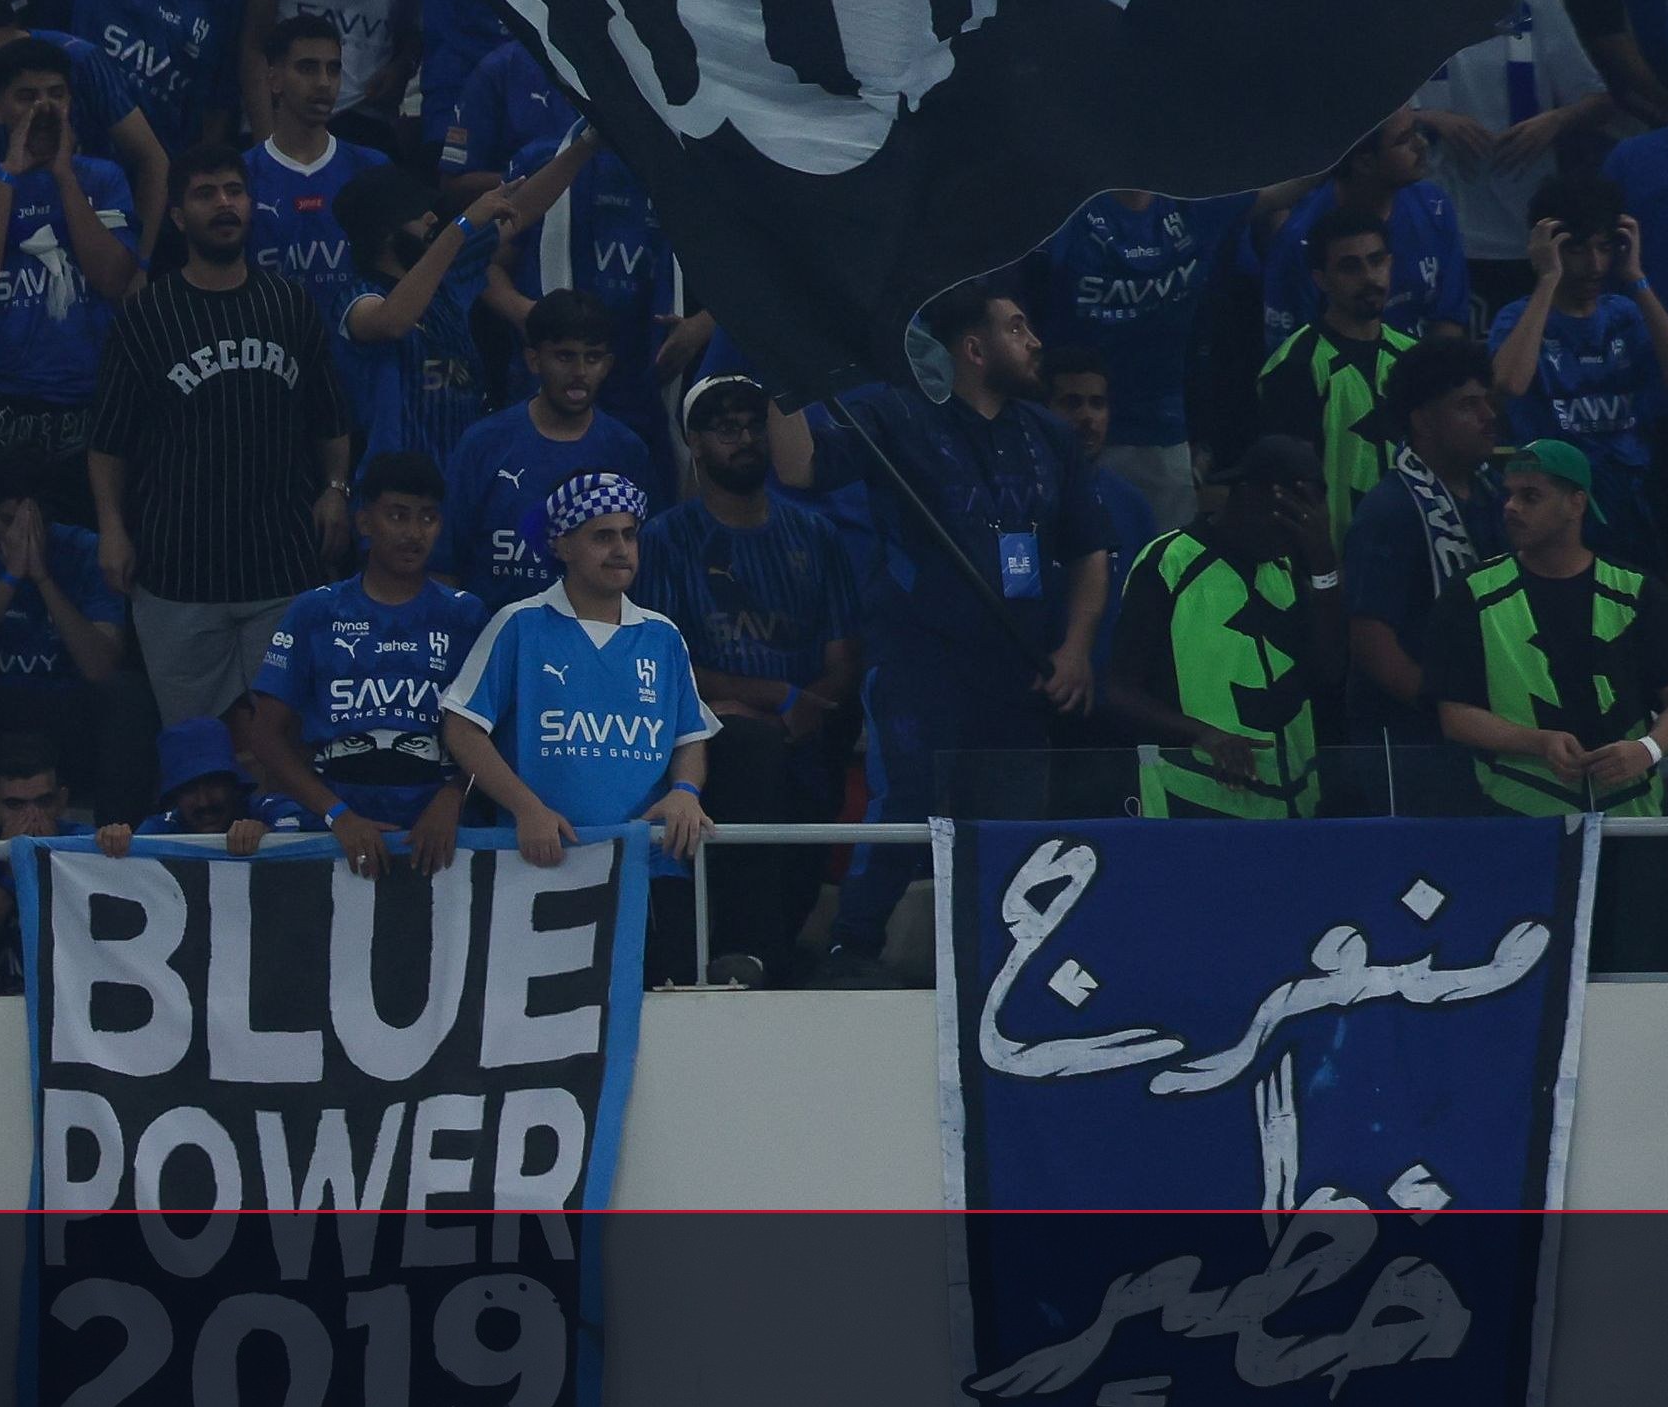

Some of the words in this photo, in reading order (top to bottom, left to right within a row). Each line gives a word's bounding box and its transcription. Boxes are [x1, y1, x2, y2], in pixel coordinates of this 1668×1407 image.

[104, 24, 170, 76] SAV
[257, 240, 349, 270] SAVV
[1076, 259, 1199, 304] SAVVY
[167, 337, 297, 393] RECORD
[331, 678, 444, 711] SAVVY
[395, 709, 439, 723] GROU
[540, 710, 664, 746] SAVVY
[540, 746, 599, 758] GAMES
[610, 748, 662, 761] GROUP
[50, 842, 619, 1084] BLUE
[43, 1086, 587, 1282] POWER
[48, 1273, 569, 1407] 2019
